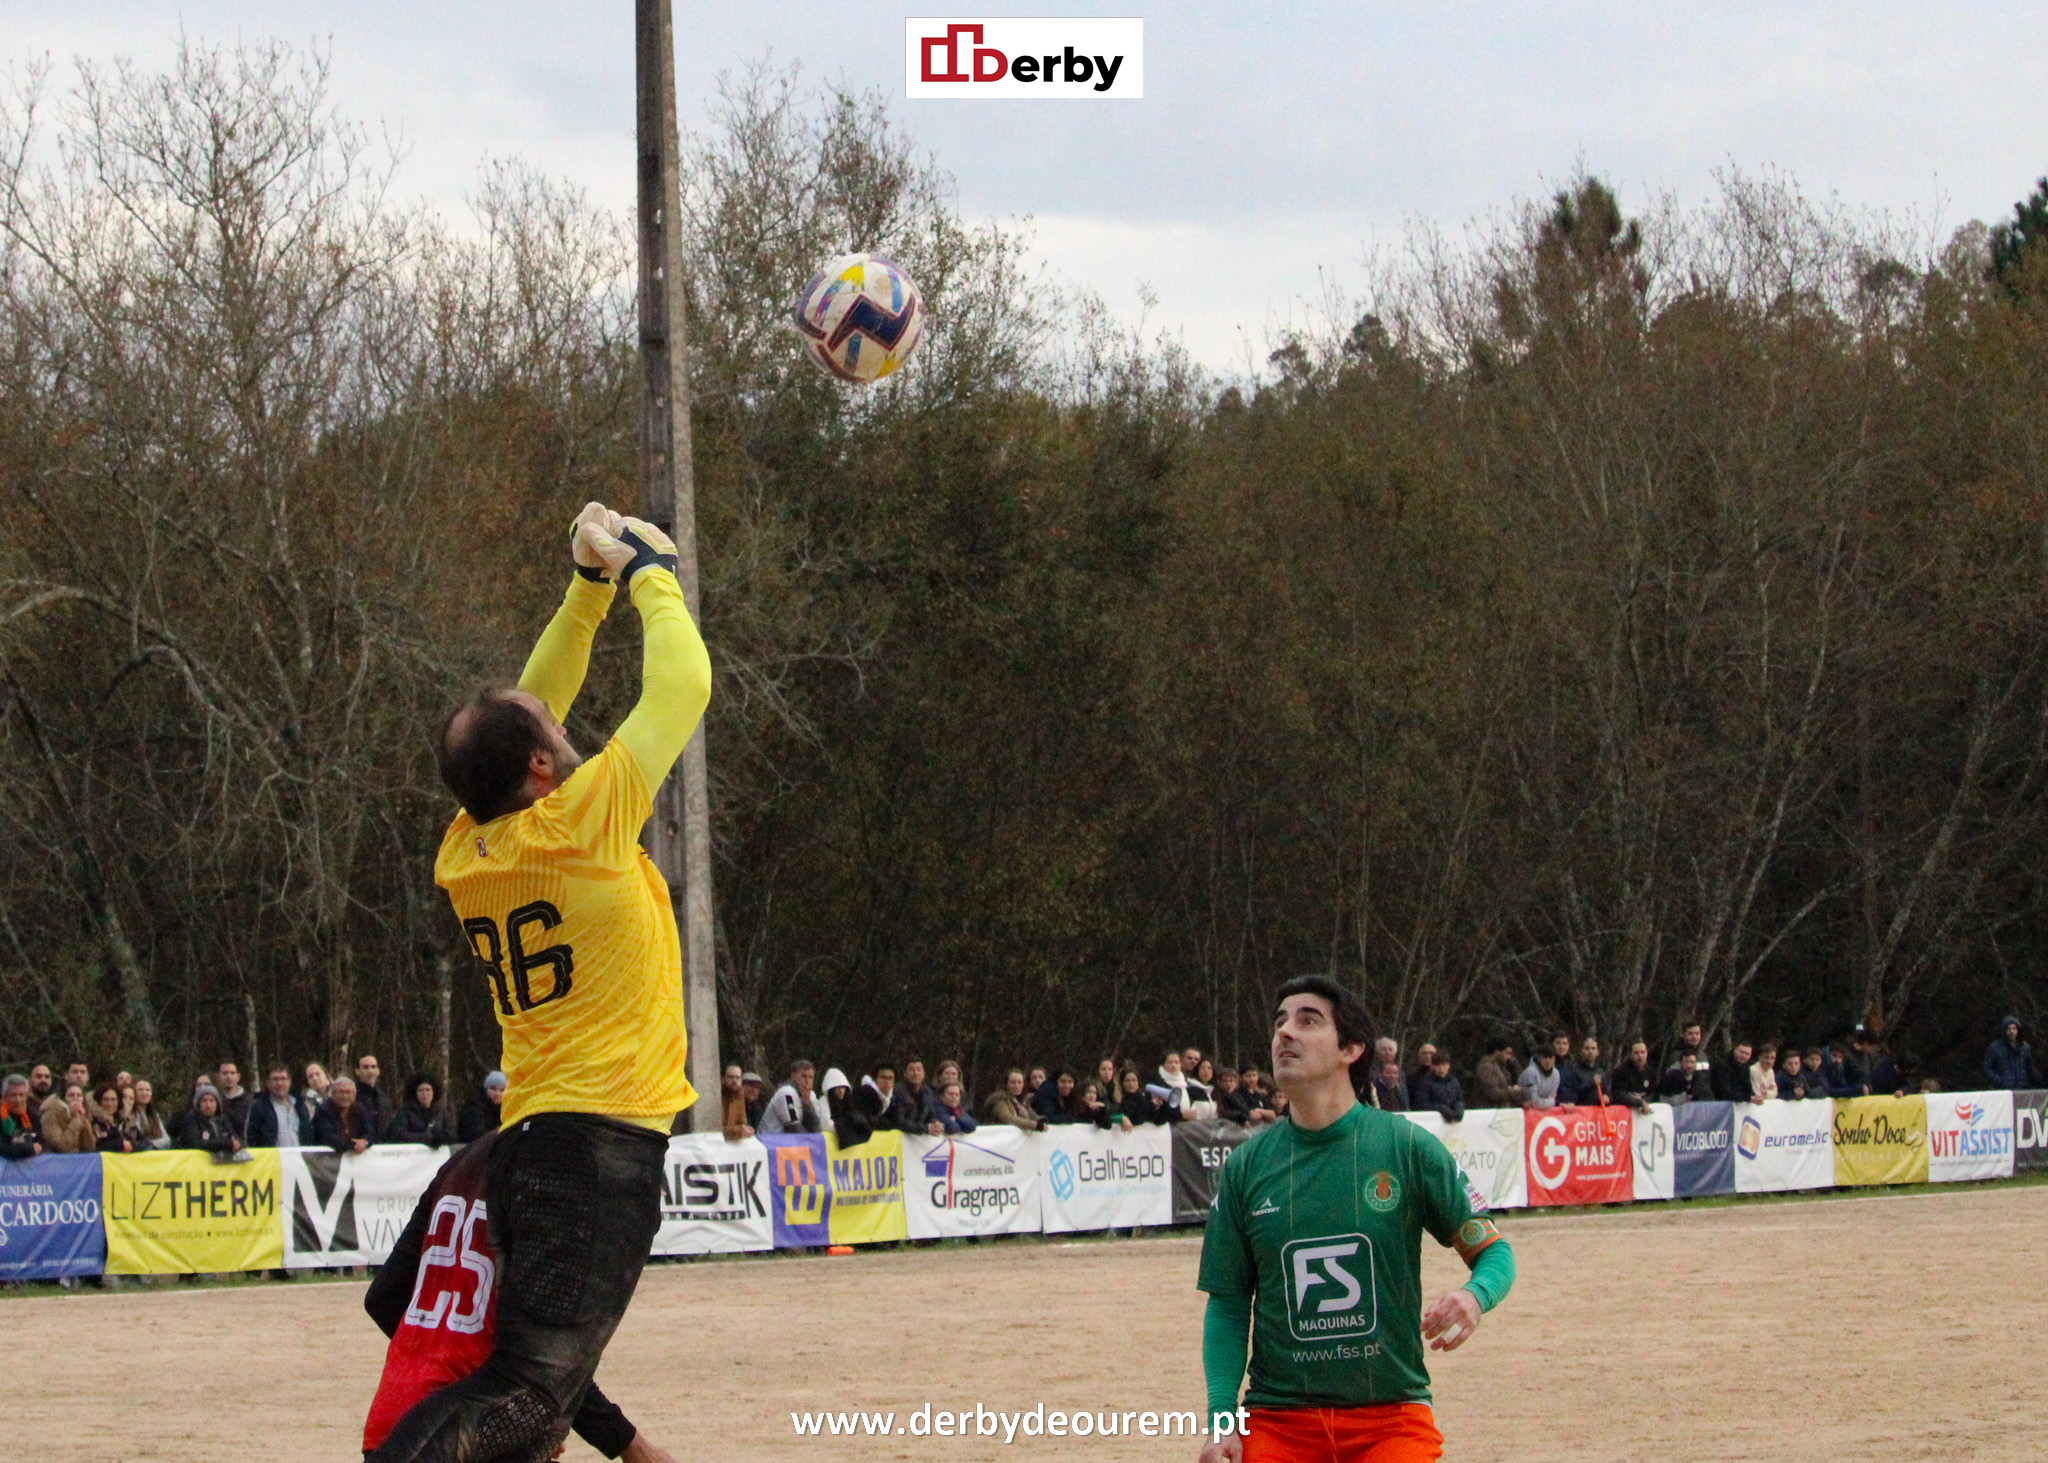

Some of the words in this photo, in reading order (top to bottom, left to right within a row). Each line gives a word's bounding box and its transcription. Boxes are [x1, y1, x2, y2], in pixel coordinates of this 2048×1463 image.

[1676, 1131, 1728, 1151] VIGOBLOCO
[1834, 1112, 1871, 1145] Sonho
[1873, 1114, 1906, 1145] Doce
[1931, 1128, 2011, 1157] VITASSIST
[1079, 1149, 1164, 1182] Galhispo
[1200, 1146, 1233, 1167] ESP
[1575, 1145, 1614, 1166] MAIS
[833, 1156, 898, 1192] MAJOR
[0, 1198, 99, 1228] CARDOSO
[111, 1178, 274, 1221] LIZTHERM
[377, 1196, 417, 1214] GRUP
[404, 1194, 495, 1334] 25
[1293, 1242, 1361, 1313] FS
[1299, 1314, 1366, 1332] MAQUINAS
[1292, 1342, 1382, 1363] www.fss.pt
